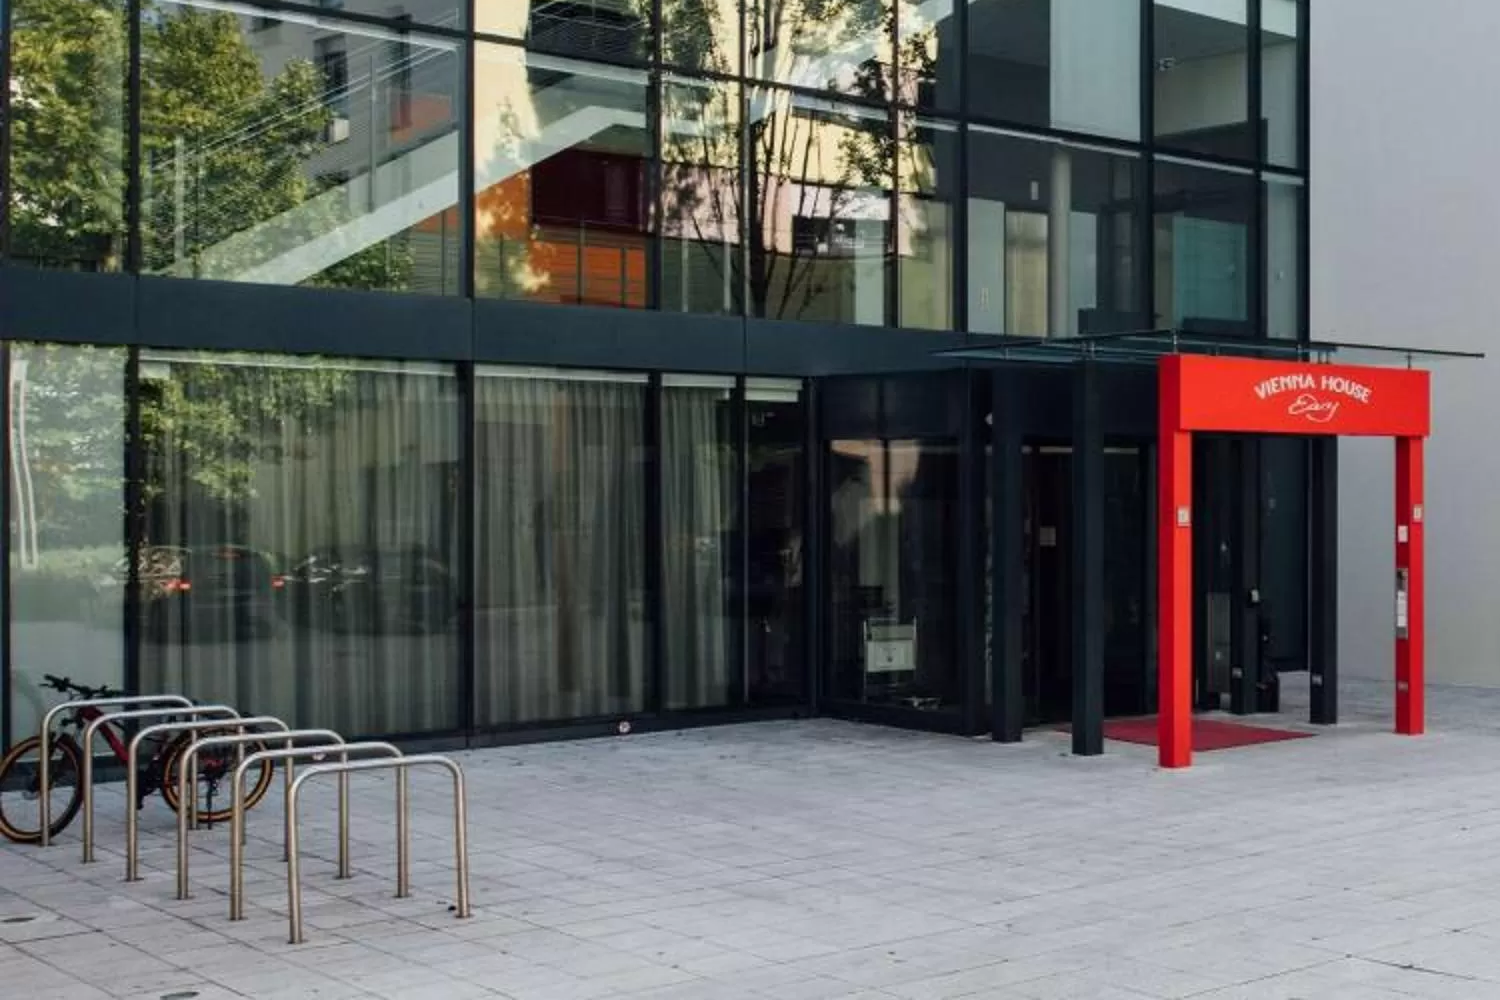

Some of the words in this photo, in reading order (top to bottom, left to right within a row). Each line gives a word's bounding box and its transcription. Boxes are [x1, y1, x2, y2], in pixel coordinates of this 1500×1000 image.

[1254, 373, 1316, 399] VIENNA
[1321, 375, 1372, 403] HOUSE
[1288, 393, 1340, 423] Easy
